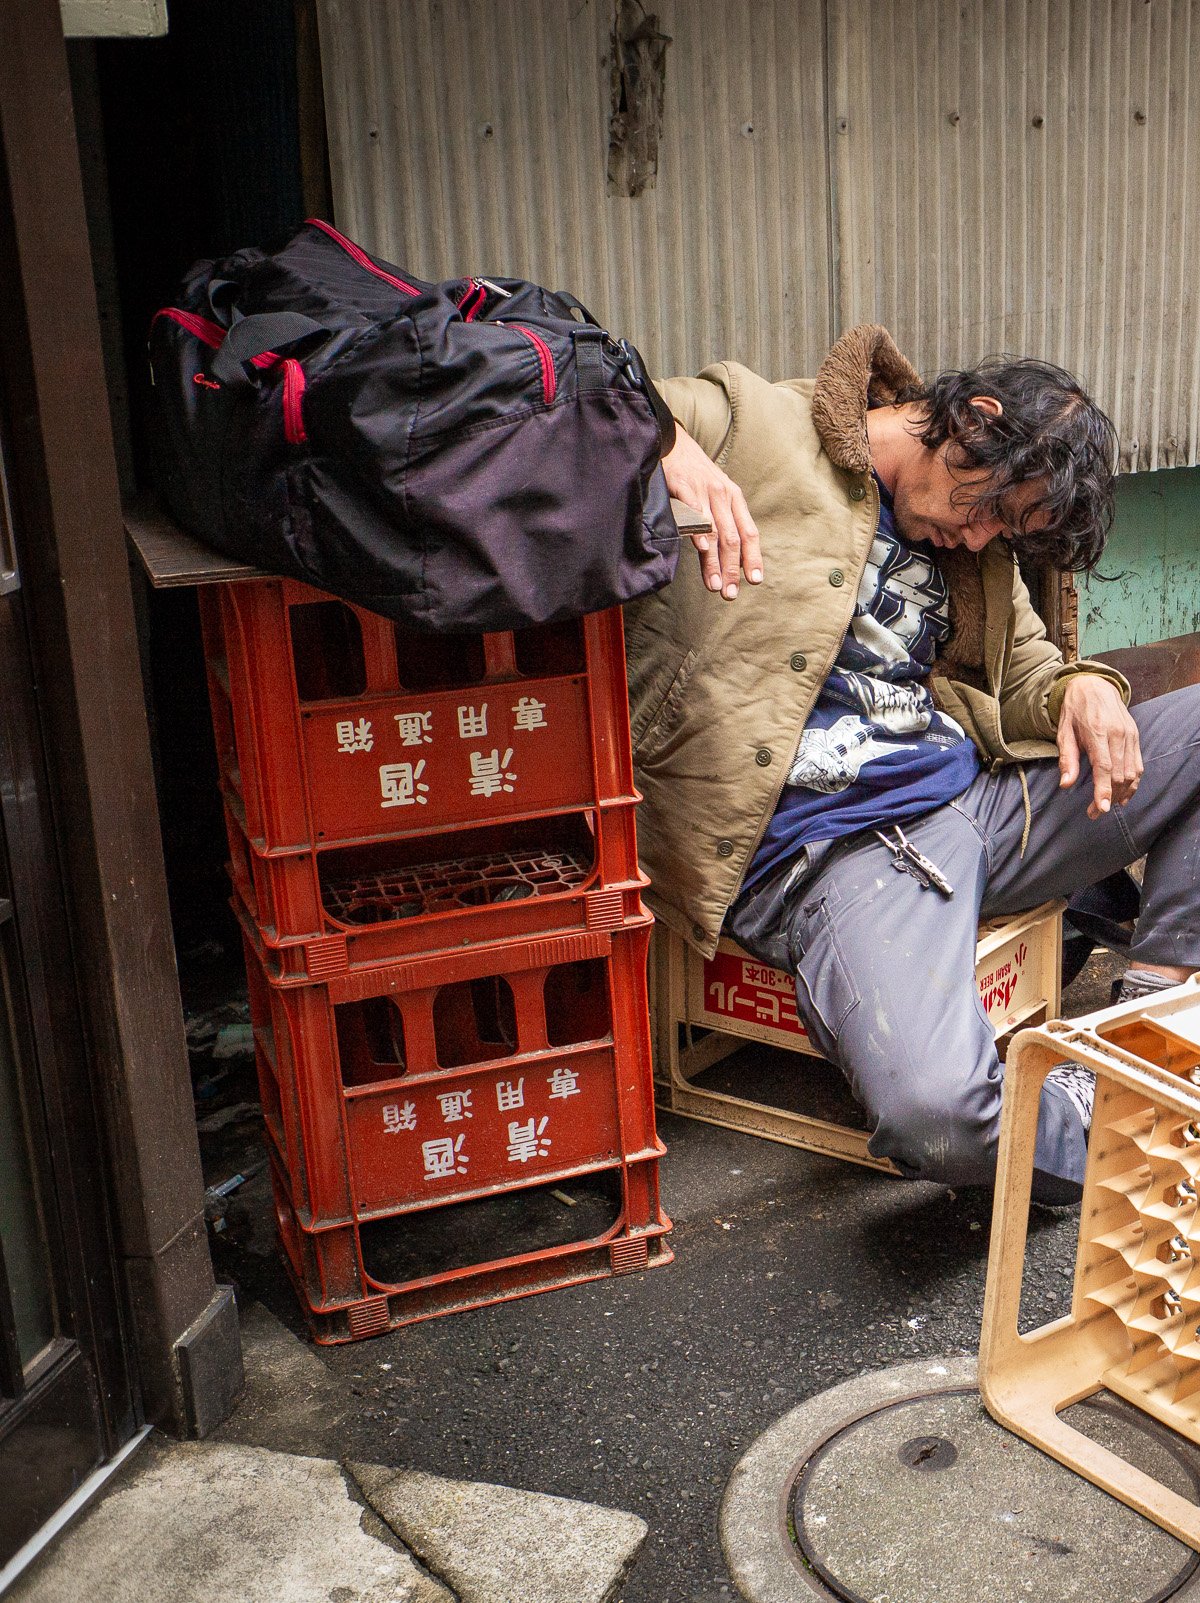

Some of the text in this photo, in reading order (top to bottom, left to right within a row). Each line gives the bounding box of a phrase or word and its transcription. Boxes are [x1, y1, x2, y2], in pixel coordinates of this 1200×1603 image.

[379, 748, 517, 808] 清酒
[980, 961, 1011, 991] ASAHI BEER
[422, 1116, 552, 1181] 清酒
